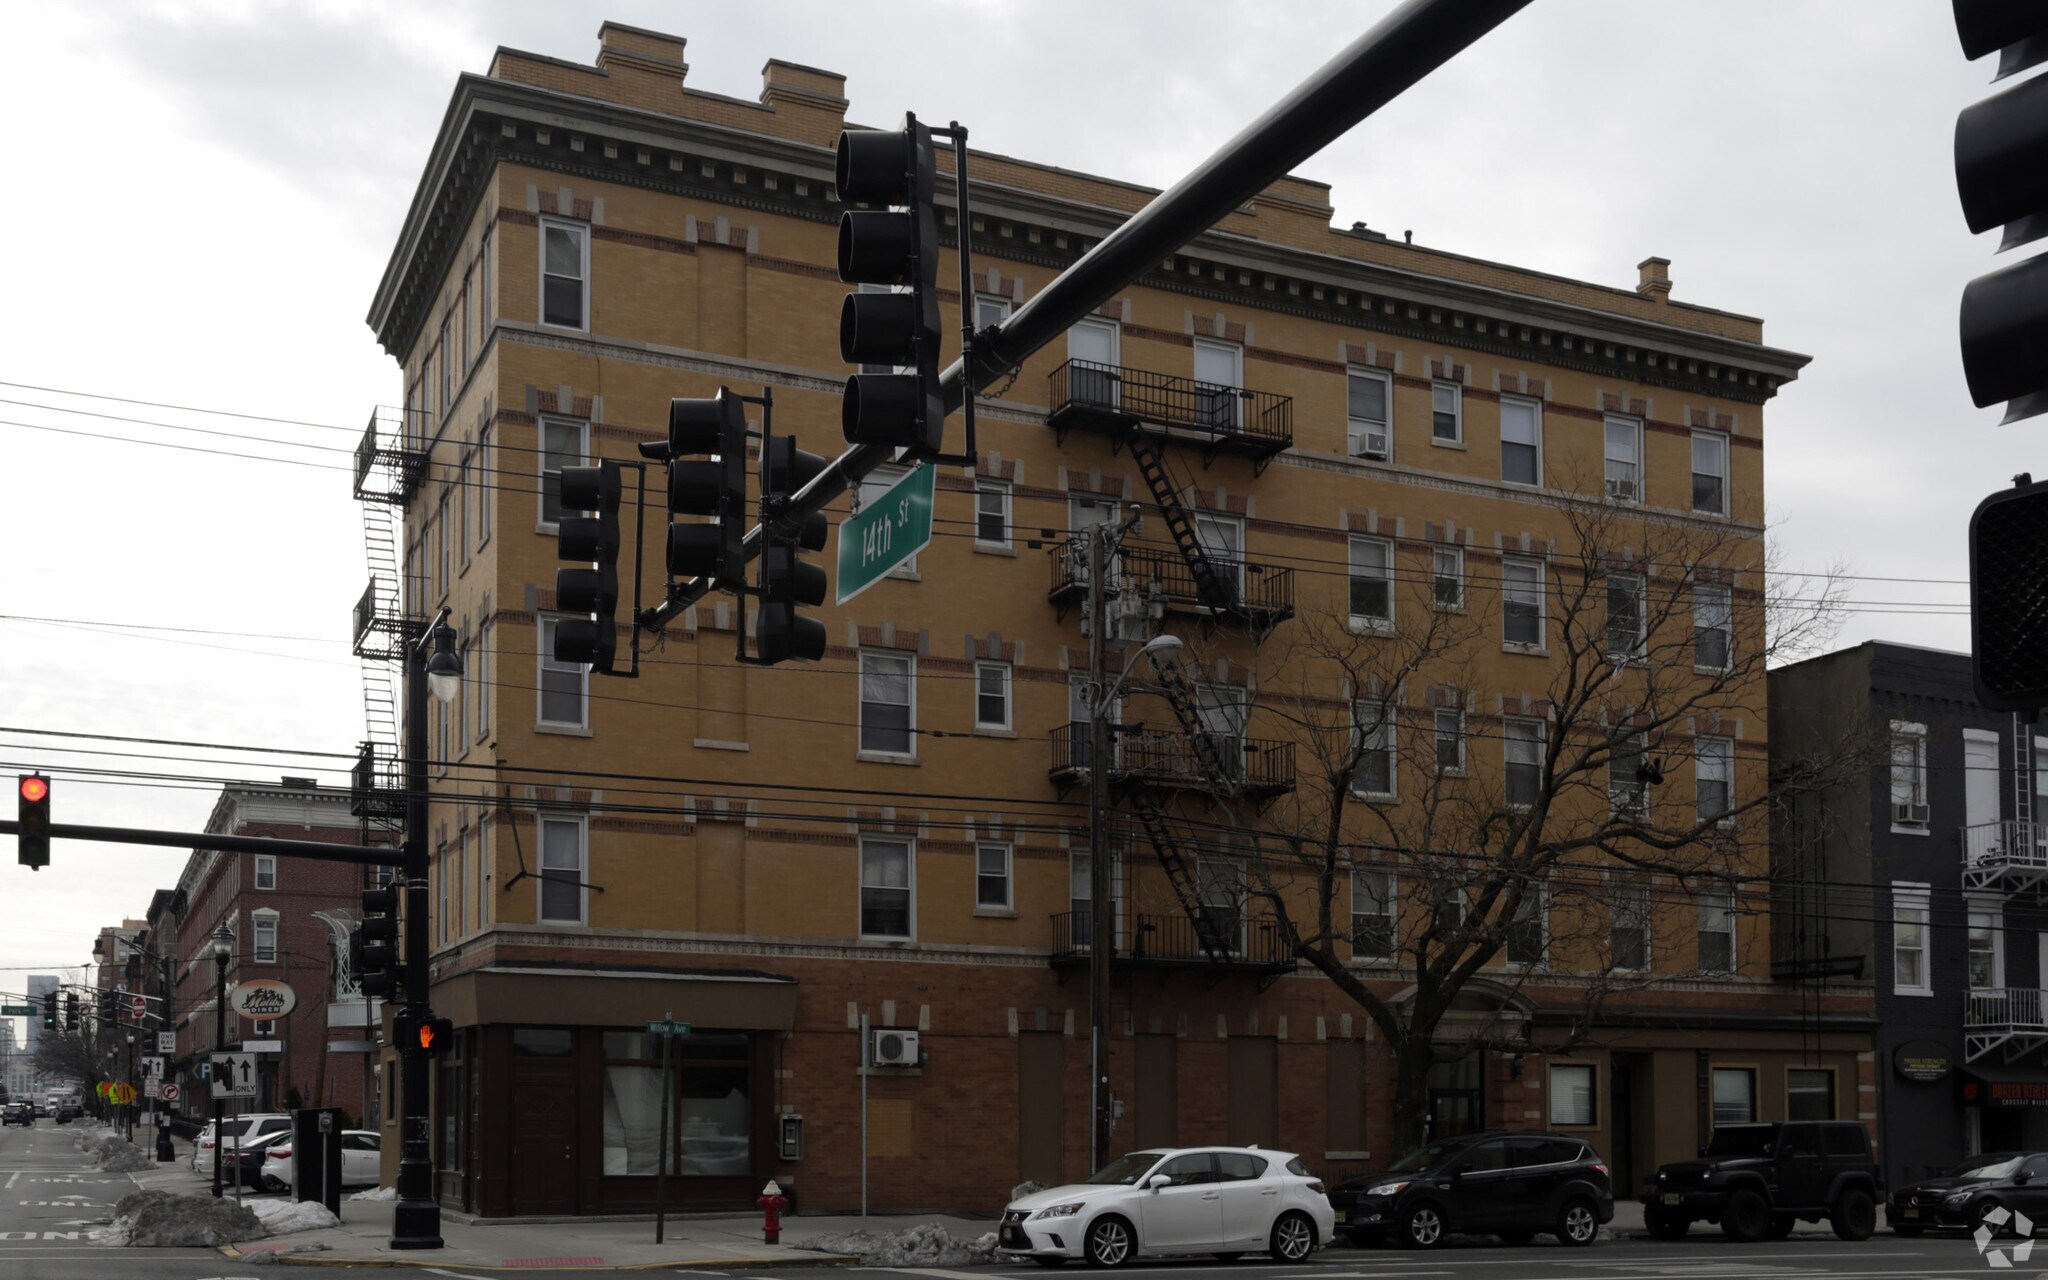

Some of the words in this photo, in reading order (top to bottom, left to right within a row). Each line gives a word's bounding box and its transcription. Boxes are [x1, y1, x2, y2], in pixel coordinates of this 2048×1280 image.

[862, 512, 891, 568] 14th
[898, 497, 909, 527] St
[243, 995, 285, 1008] Malibu
[649, 1024, 670, 1032] Willow
[673, 1024, 687, 1033] Ave
[235, 1085, 256, 1093] ONLY
[1992, 1083, 2022, 1098] BRAZEN
